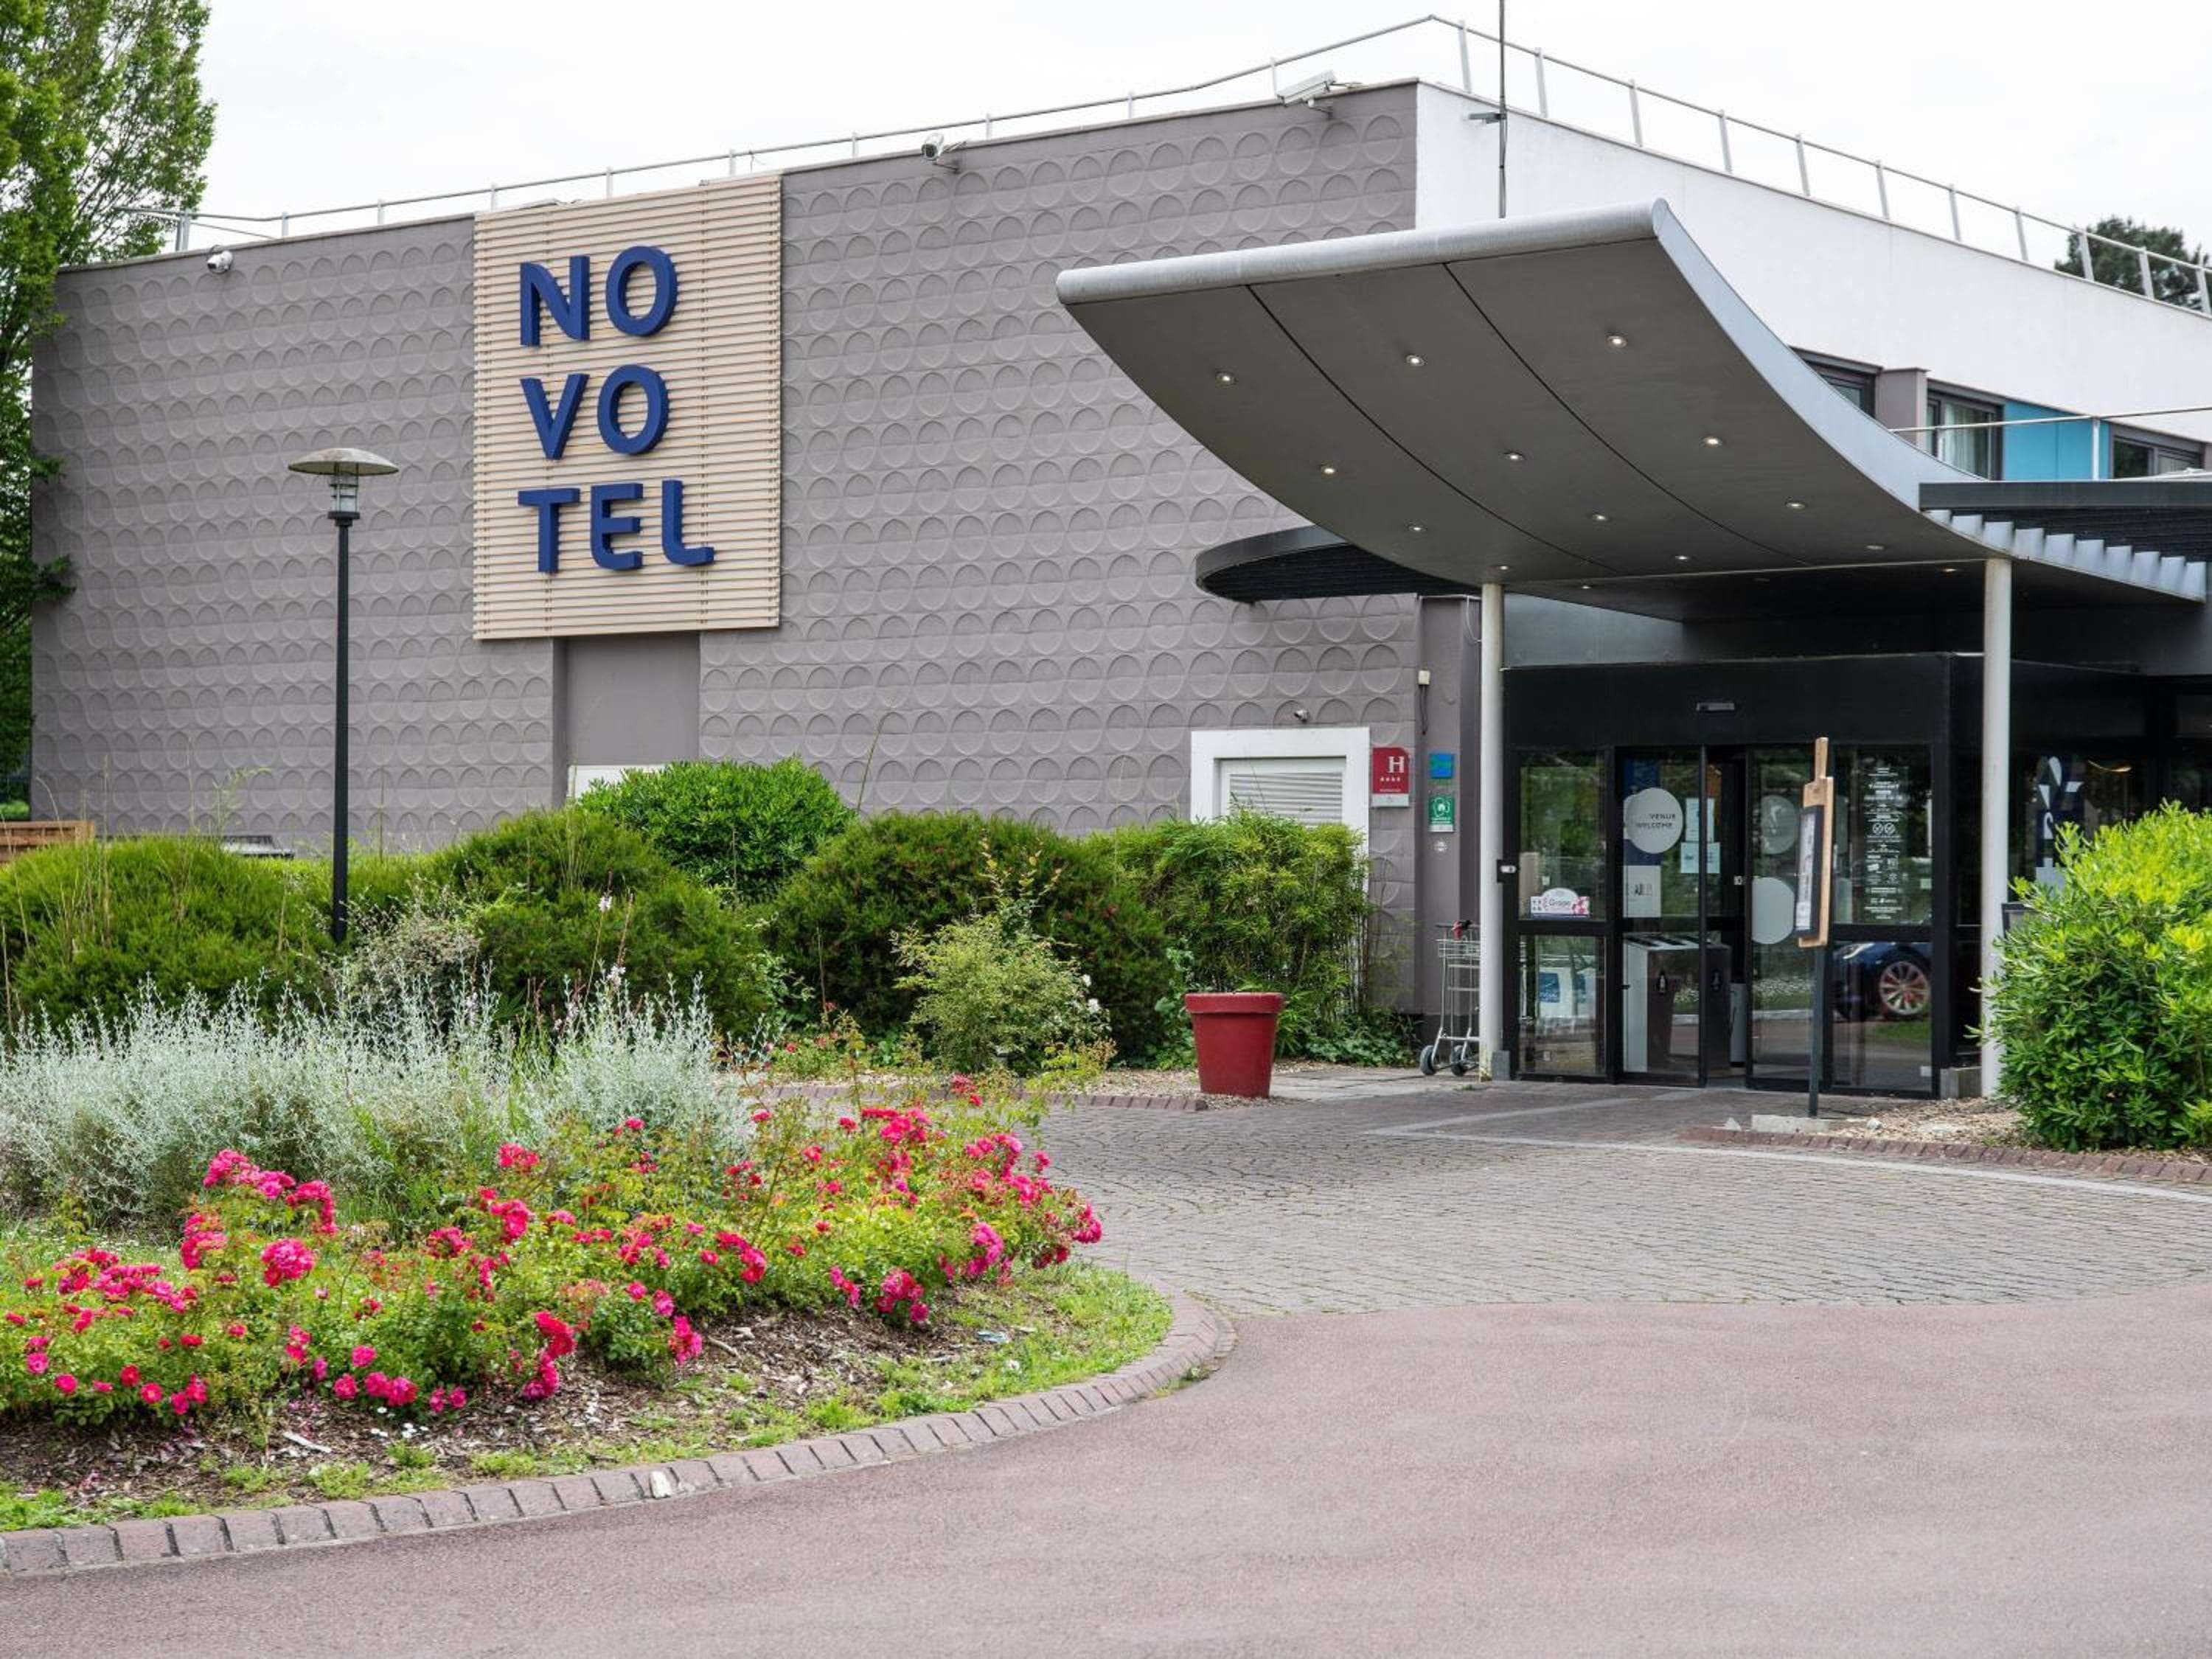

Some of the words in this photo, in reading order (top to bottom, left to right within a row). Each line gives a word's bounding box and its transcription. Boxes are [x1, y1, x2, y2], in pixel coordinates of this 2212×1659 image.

[520, 246, 678, 347] NO
[520, 364, 669, 460] VO
[518, 479, 714, 574] TEL
[1388, 756, 1405, 773] H
